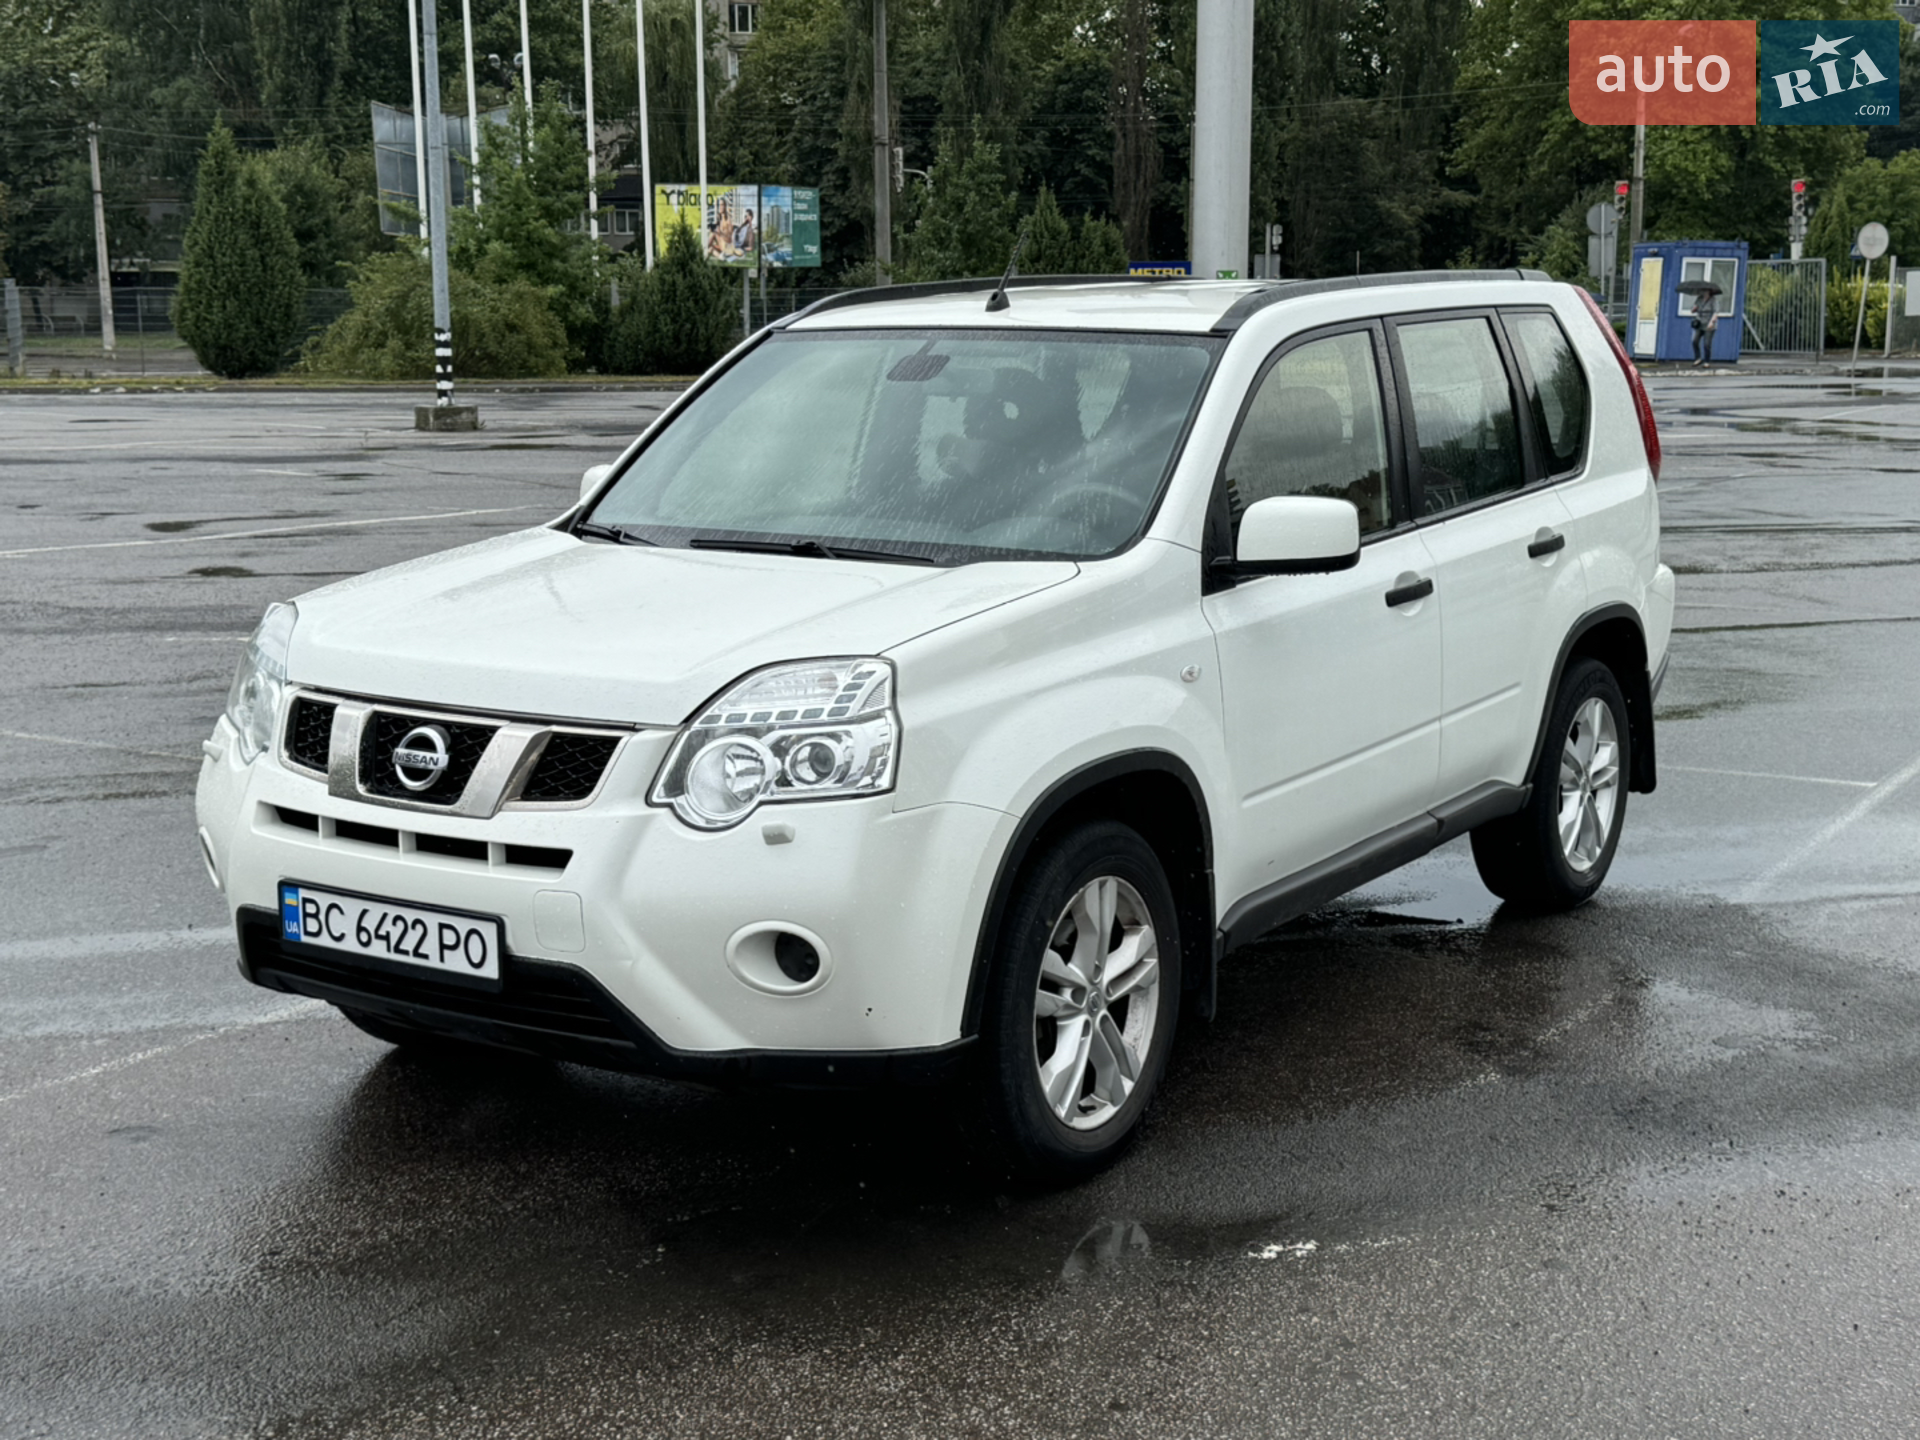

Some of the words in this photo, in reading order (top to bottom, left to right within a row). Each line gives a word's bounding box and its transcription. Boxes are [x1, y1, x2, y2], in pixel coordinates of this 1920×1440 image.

[395, 751, 440, 767] NISSAN
[284, 919, 300, 935] UA
[301, 896, 346, 943] BC
[356, 908, 430, 961] 6422
[438, 922, 488, 970] PO
